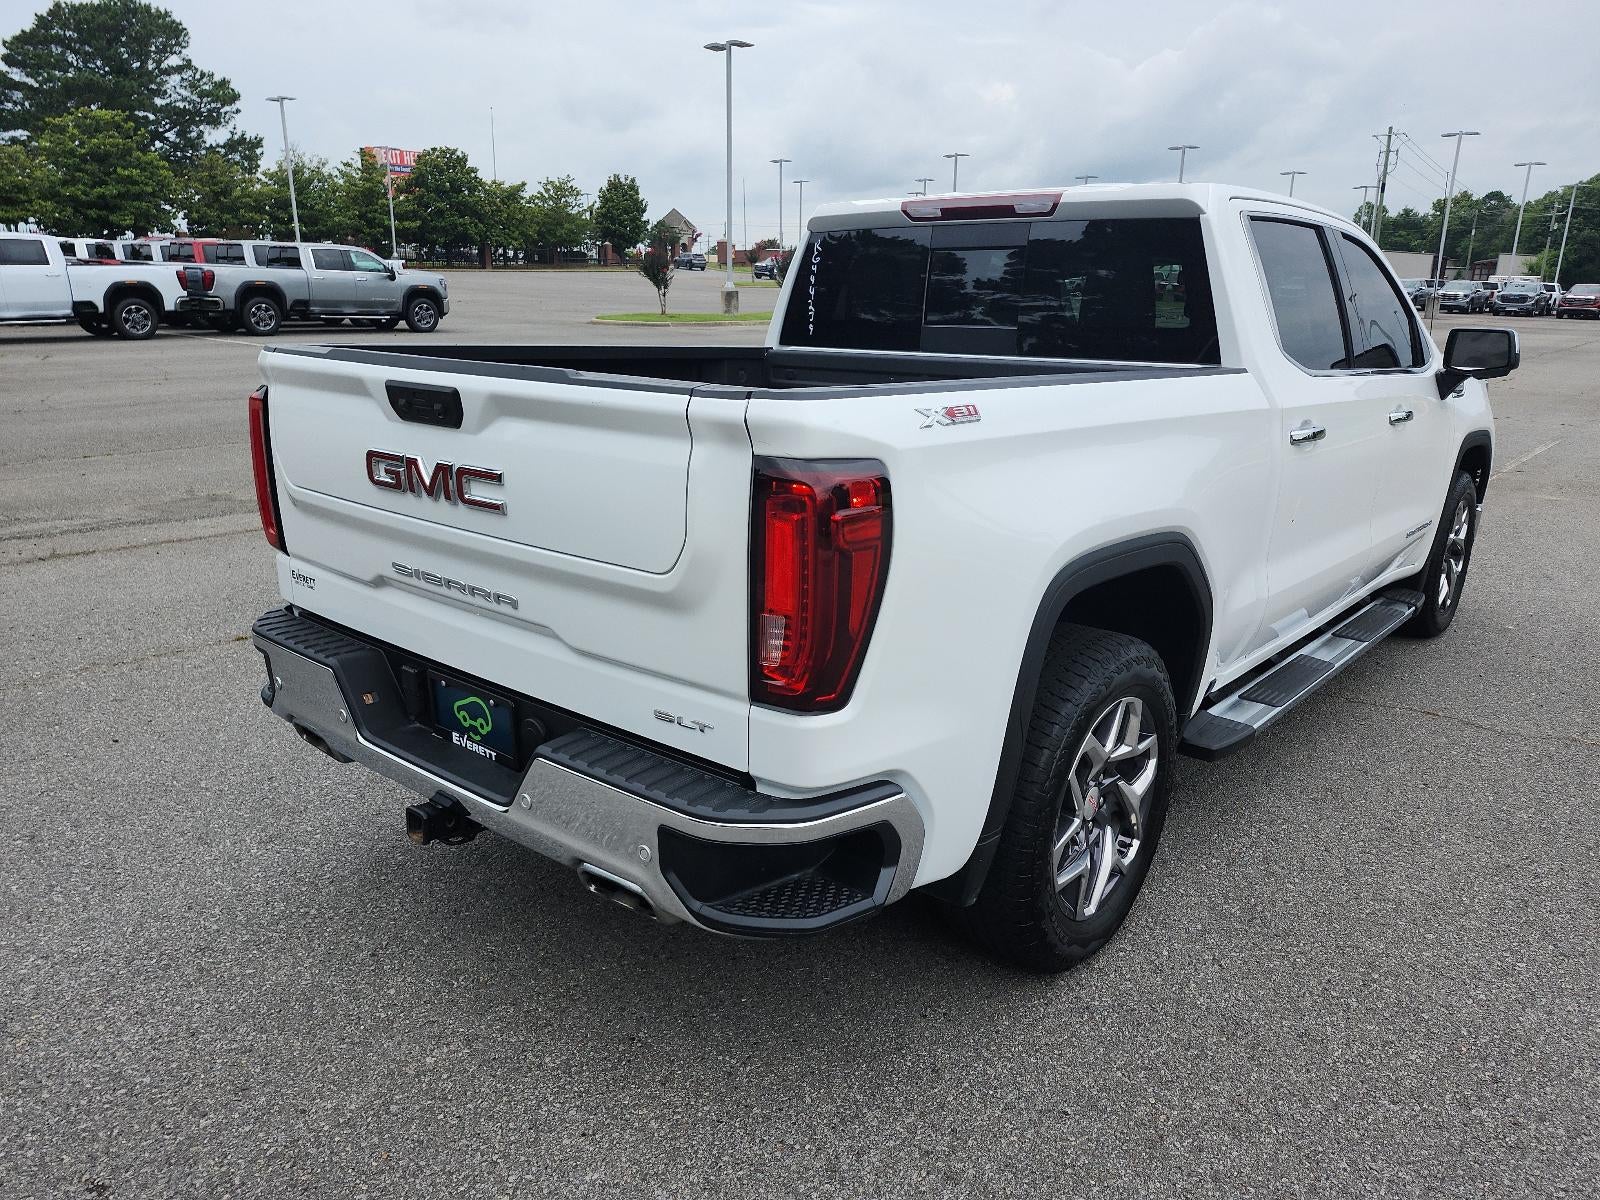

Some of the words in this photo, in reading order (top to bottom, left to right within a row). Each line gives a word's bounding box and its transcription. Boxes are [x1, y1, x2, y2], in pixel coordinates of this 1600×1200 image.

[366, 448, 508, 516] GMC
[391, 561, 519, 610] SIERRA
[653, 709, 715, 733] SLT
[452, 731, 497, 761] EVERETT
